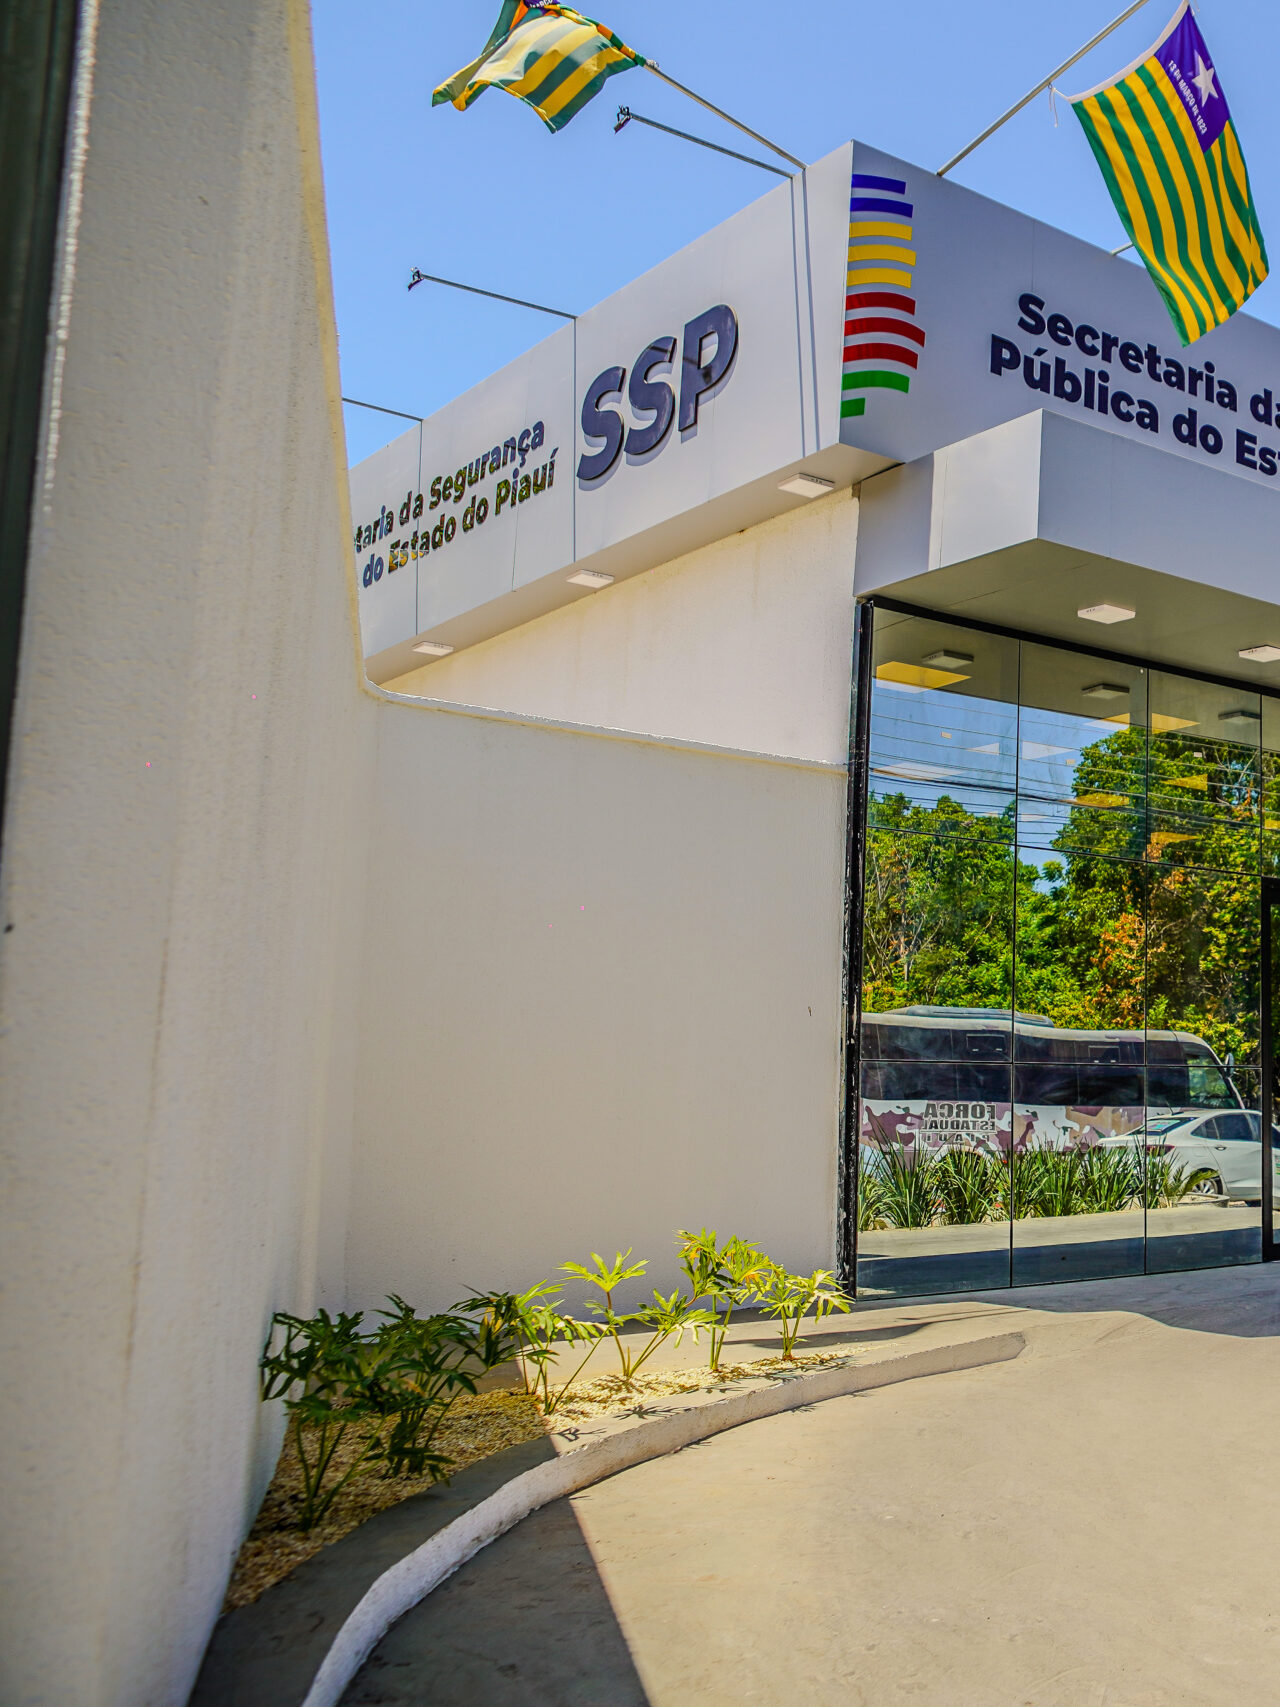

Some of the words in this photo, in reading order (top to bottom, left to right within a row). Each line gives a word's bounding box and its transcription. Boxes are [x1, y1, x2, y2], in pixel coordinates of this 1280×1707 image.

[1196, 115, 1208, 135] 1823
[576, 303, 740, 481] SSP
[990, 333, 1160, 434] Pública
[1173, 407, 1224, 455] do
[1018, 292, 1238, 413] Secretaria
[354, 505, 394, 553] taria
[399, 490, 424, 526] da
[429, 420, 545, 510] Segurança
[362, 553, 384, 588] do
[388, 513, 457, 574] Estado
[462, 495, 489, 533] do
[495, 447, 559, 516] Piauí
